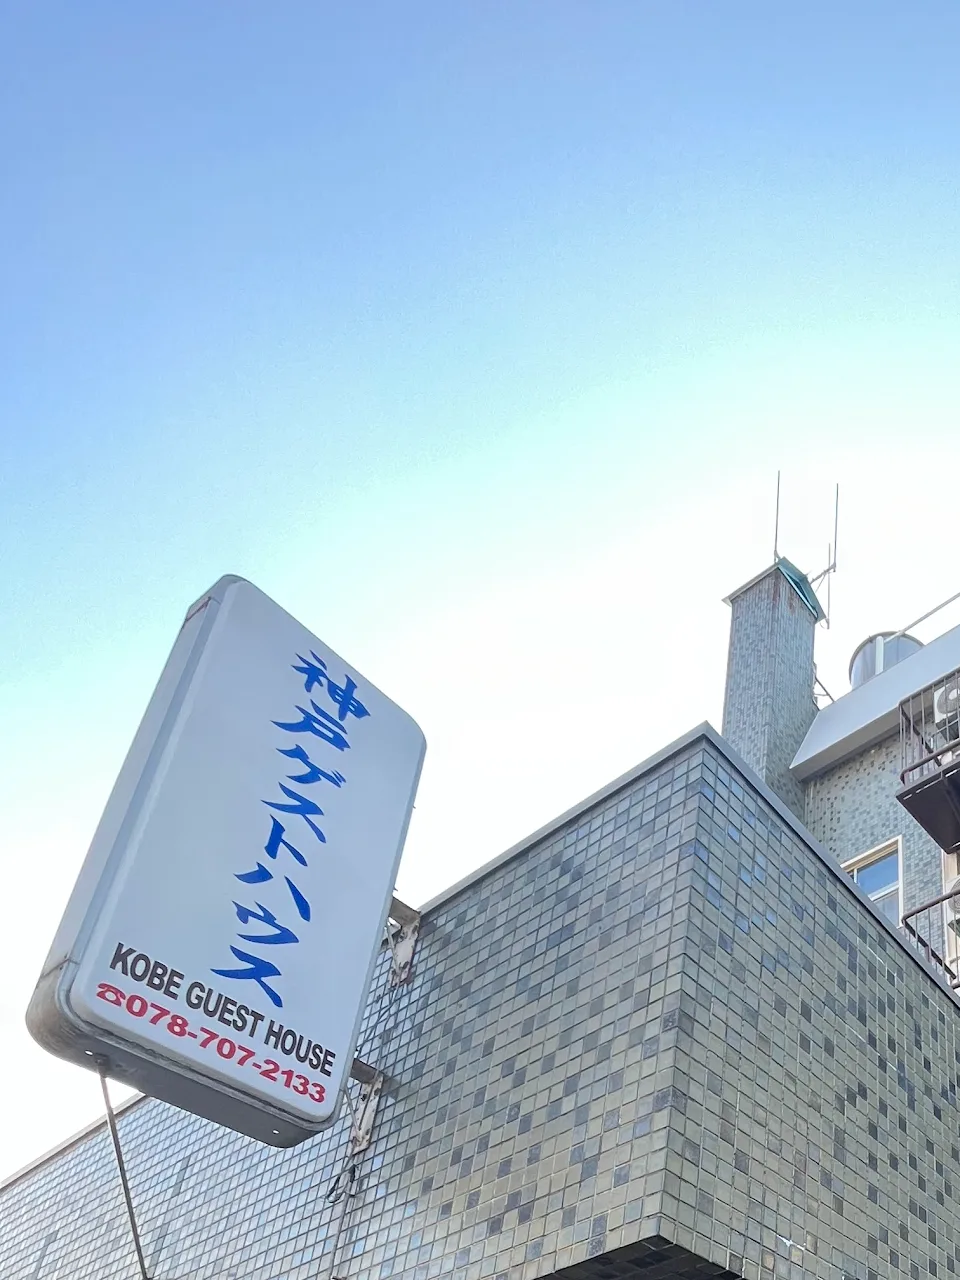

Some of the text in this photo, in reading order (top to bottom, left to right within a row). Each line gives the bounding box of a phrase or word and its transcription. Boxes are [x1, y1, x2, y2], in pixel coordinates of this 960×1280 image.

[210, 650, 370, 1008] 神戸ゲストハウス
[109, 942, 336, 1077] KOBE GUEST HOUSE
